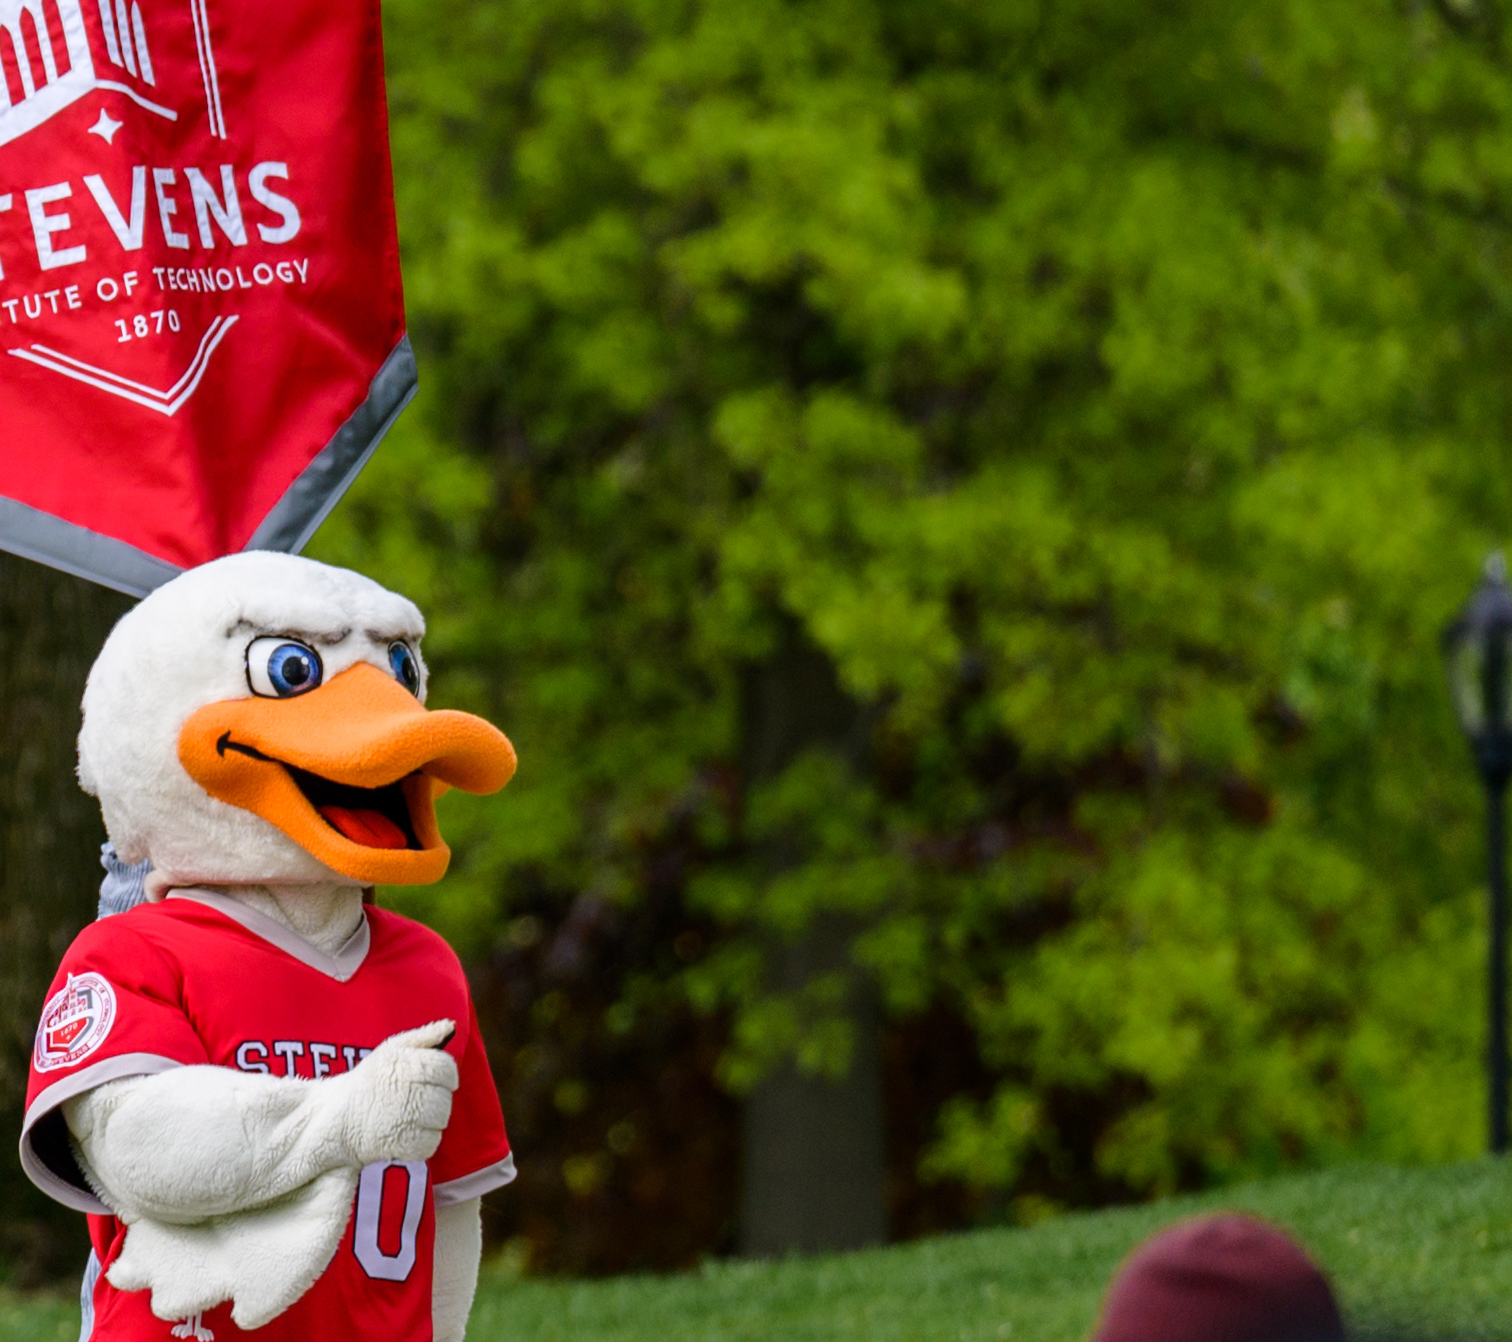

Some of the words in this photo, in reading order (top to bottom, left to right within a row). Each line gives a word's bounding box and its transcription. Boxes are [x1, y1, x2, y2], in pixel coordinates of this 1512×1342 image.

[97, 271, 139, 302] OF
[153, 259, 309, 294] TECHNOLOGY
[115, 309, 181, 343] 1870
[60, 1022, 79, 1037] 1870
[353, 1158, 429, 1283] 0
